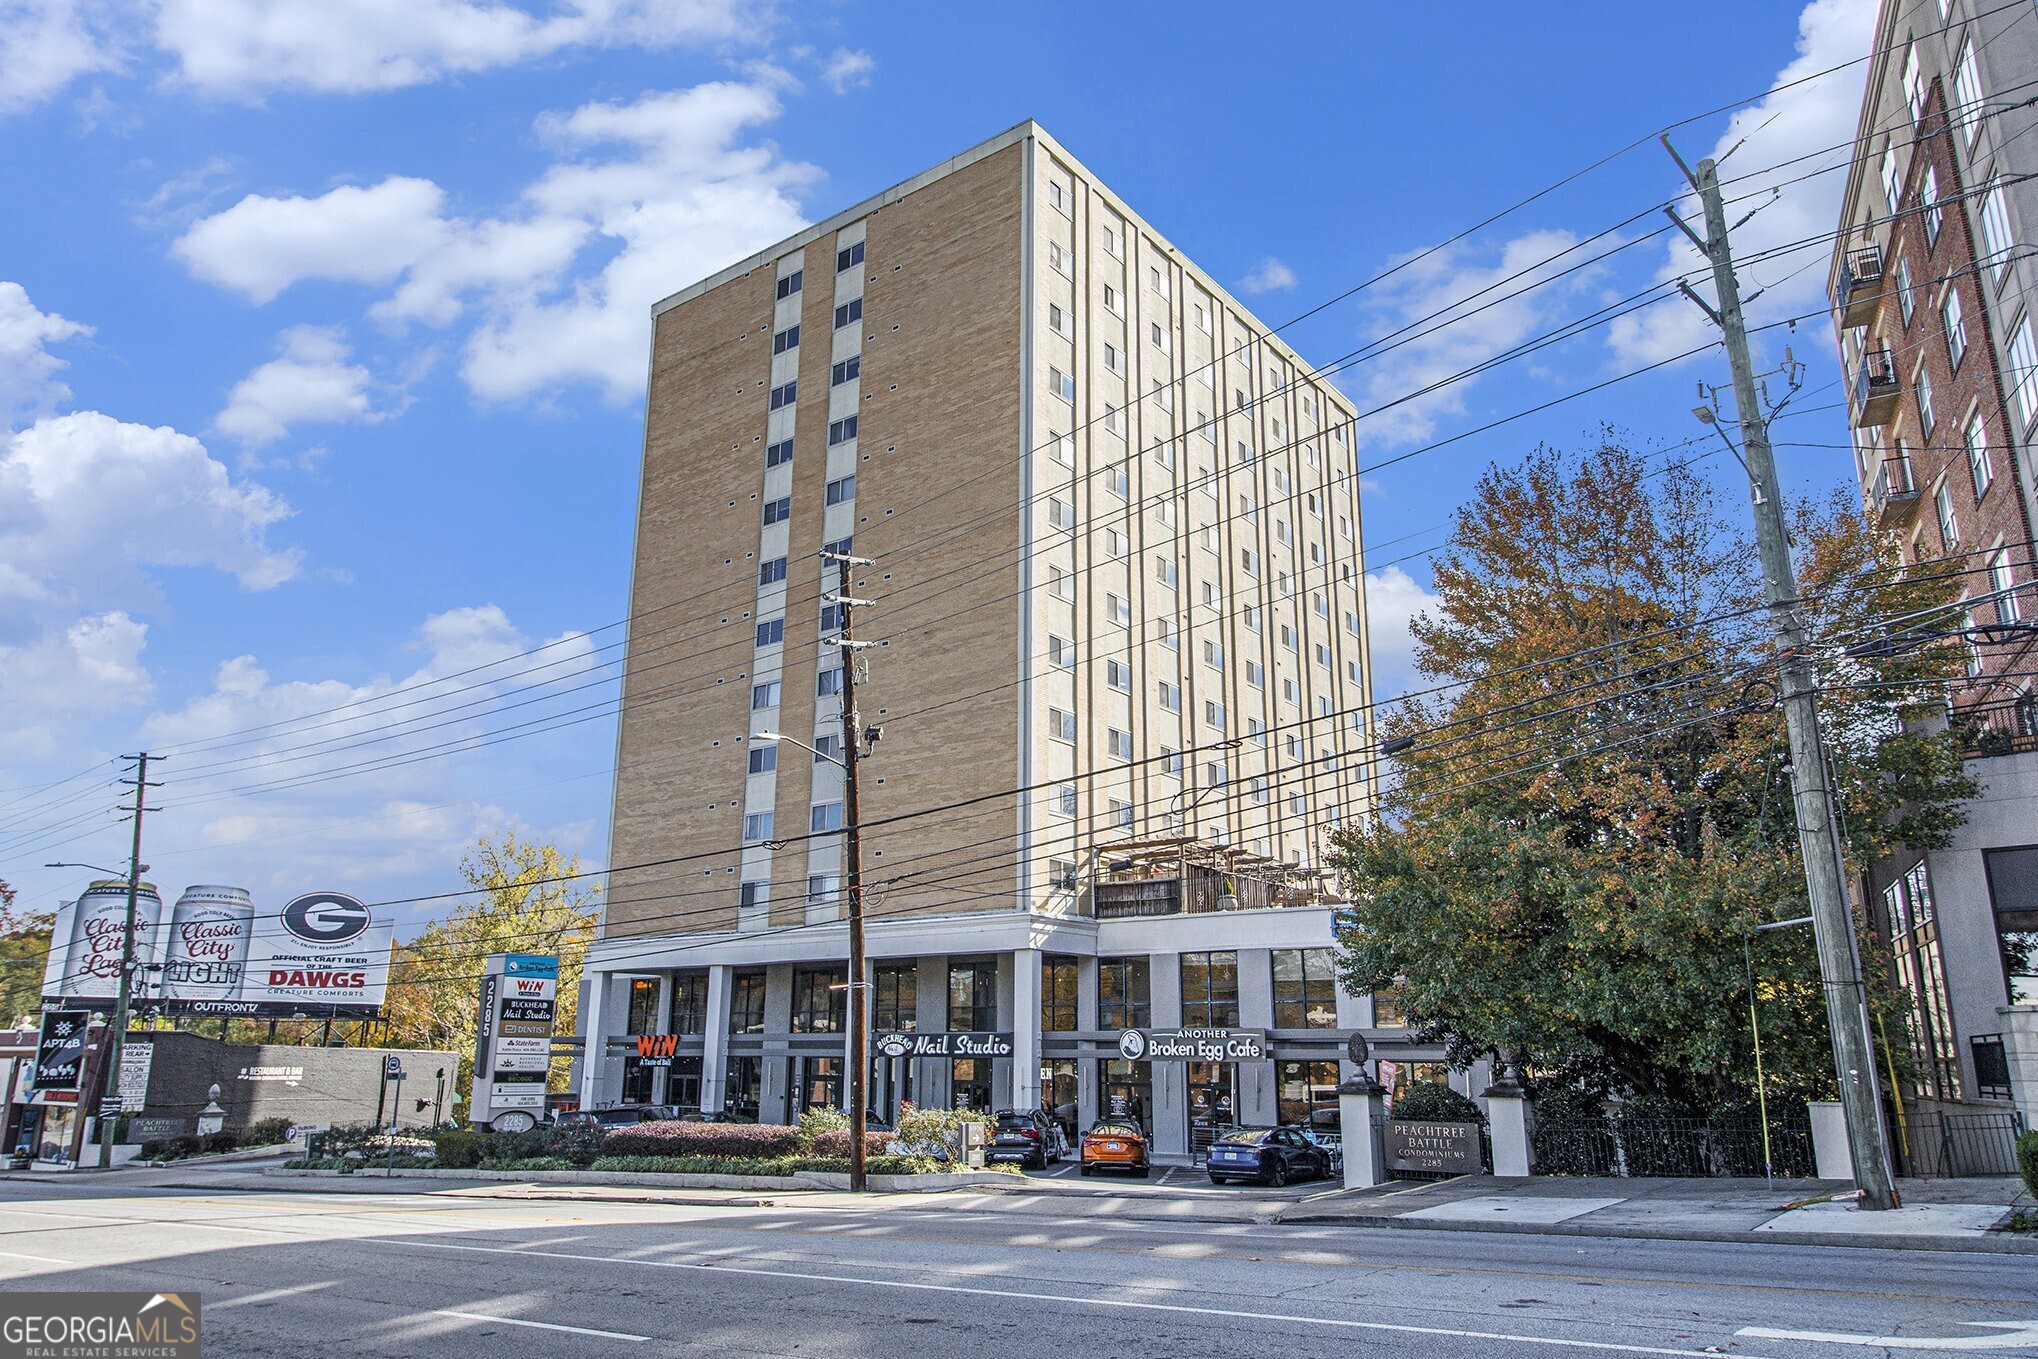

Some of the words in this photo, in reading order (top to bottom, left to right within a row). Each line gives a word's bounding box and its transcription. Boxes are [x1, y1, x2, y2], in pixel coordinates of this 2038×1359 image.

[84, 918, 149, 937] Clasic
[181, 922, 242, 941] Classic
[186, 939, 236, 961] City
[272, 954, 311, 963] OFFICIAL
[314, 956, 343, 964] CRAFT
[345, 957, 368, 965] BEER
[167, 961, 241, 984] LIGHT
[268, 970, 366, 988] DAWGS
[267, 988, 313, 996] CREATURE
[511, 1001, 549, 1009] BUCKHEAD
[503, 1009, 522, 1019] Nail
[525, 1010, 551, 1020] Studio
[518, 1026, 546, 1034] DENTIST
[1177, 1029, 1227, 1038] ANOTHER
[42, 1038, 81, 1049] APT4B
[876, 1034, 914, 1050] BUCKHEAD
[913, 1035, 949, 1054] Nail
[954, 1034, 1011, 1054] Studio
[1149, 1039, 1195, 1056] Broken
[1198, 1040, 1225, 1061] Egg
[1227, 1039, 1260, 1057] Cafe
[250, 1066, 286, 1076] RESTAURANT
[504, 1115, 523, 1127] 2285
[1394, 1125, 1466, 1138] PEACHTREE
[1408, 1137, 1453, 1149] BATTLE
[1398, 1148, 1465, 1159] CONDOMINIUMS
[1421, 1159, 1442, 1167] 2285
